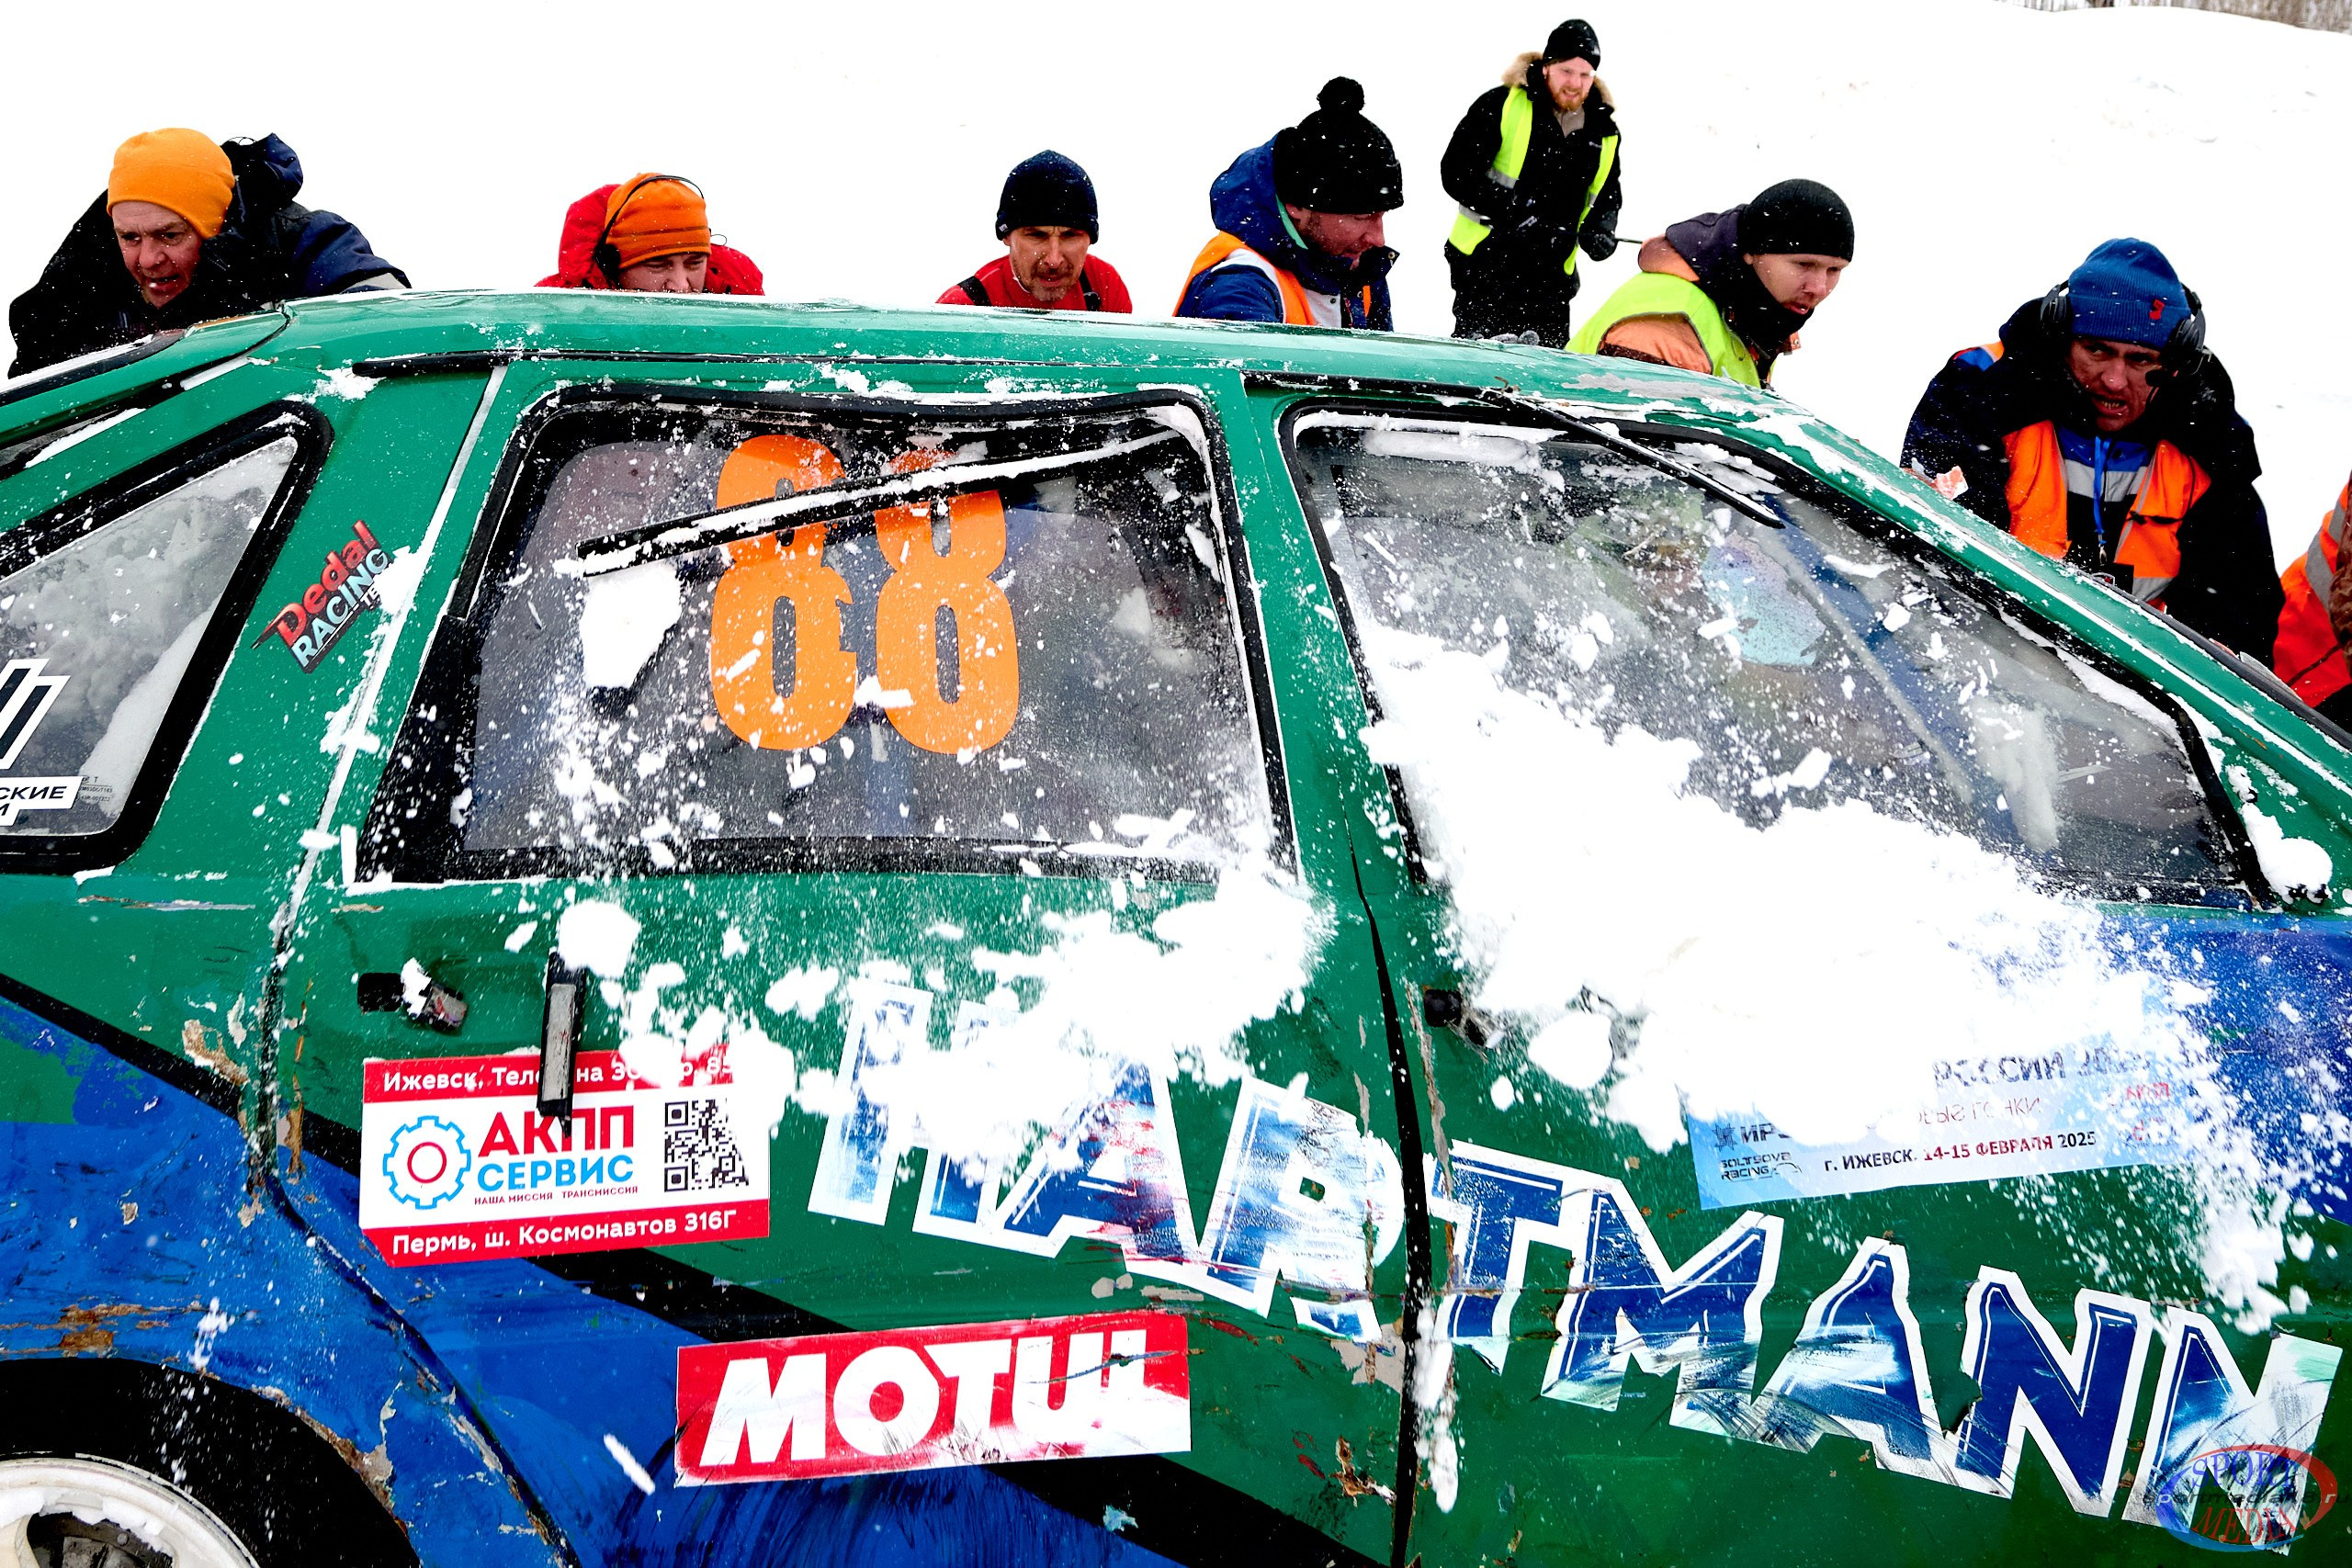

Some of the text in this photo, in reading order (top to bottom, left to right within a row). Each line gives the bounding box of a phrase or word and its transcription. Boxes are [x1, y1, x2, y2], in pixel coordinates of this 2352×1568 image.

[251, 519, 380, 649] Dedal
[291, 548, 389, 668] RACING
[710, 435, 1019, 754] 88
[478, 1105, 634, 1157] АКПП
[1923, 1144, 1972, 1162] 14-15
[1975, 1135, 2053, 1157] ФЕВРАЛЯ
[2057, 1131, 2098, 1149] 2025
[474, 1186, 639, 1206] НАША МИССИЯ ТРАНСМИССИЯ
[477, 1154, 634, 1192] СЕРВИС
[392, 1209, 737, 1258] Пермь, ш. Космонавтов 316Г
[698, 1329, 1180, 1470] MOTUL
